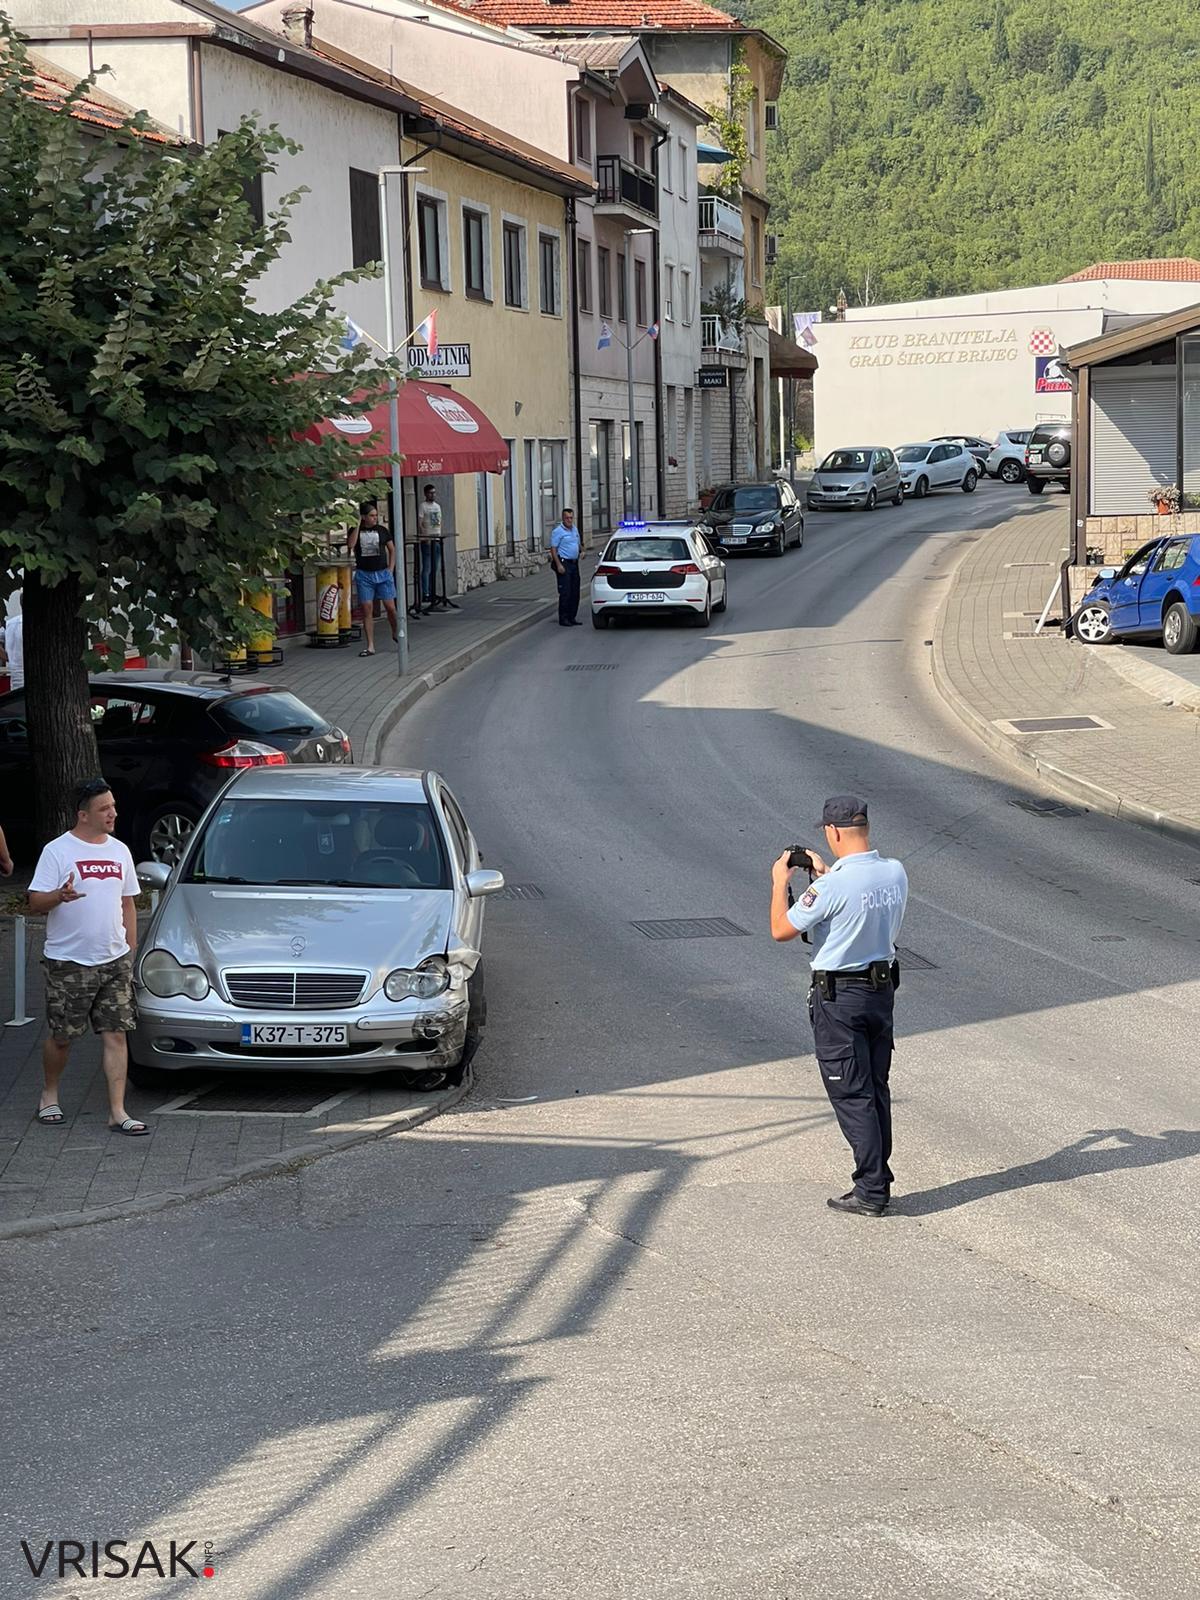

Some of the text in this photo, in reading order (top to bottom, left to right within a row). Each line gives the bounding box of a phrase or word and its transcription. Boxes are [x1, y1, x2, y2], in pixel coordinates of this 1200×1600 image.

[849, 328, 1018, 350] KLUB BRANITELJA
[849, 353, 894, 368] GRAD
[956, 347, 1018, 364] BRIJEG
[253, 1026, 345, 1043] K37-T-375
